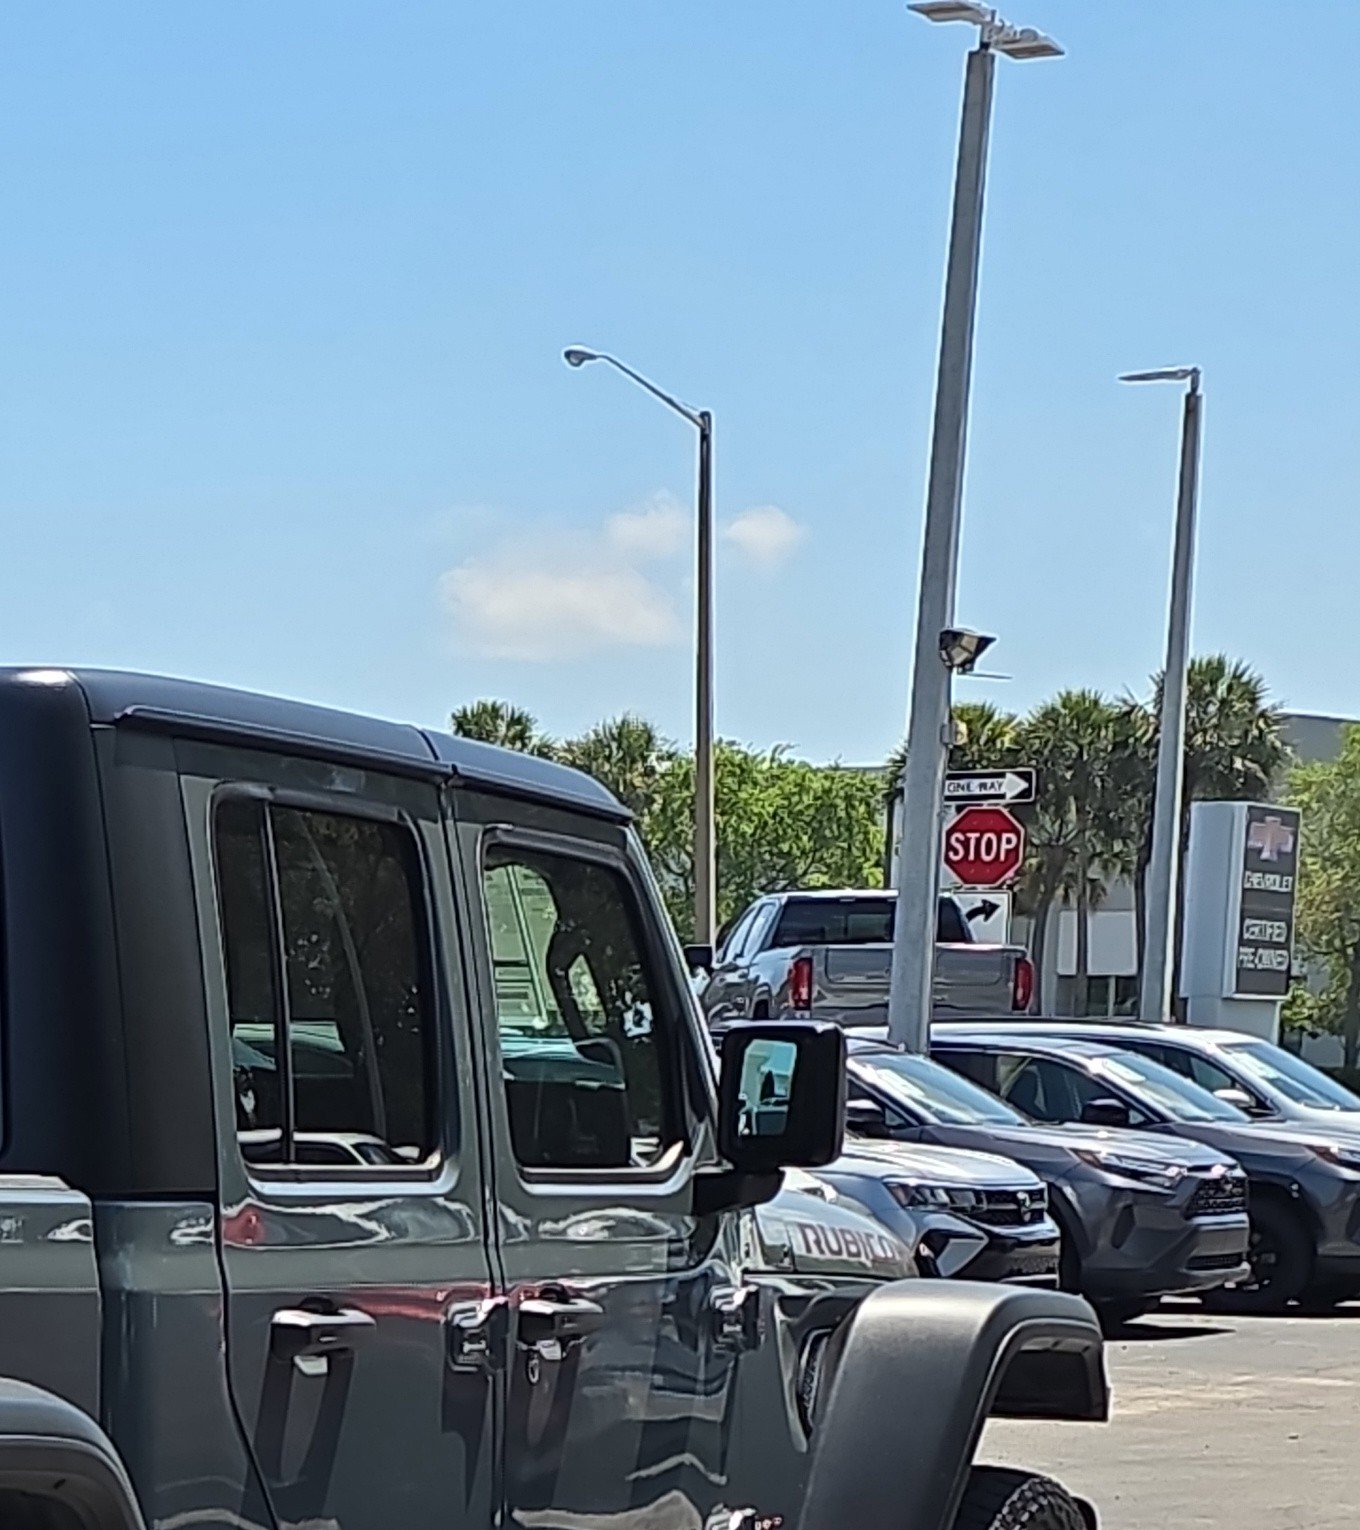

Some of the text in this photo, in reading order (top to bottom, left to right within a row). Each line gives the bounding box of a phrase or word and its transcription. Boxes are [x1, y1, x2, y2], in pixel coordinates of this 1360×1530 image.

[947, 780, 1004, 793] ONE WAY
[948, 832, 1018, 862] STOP
